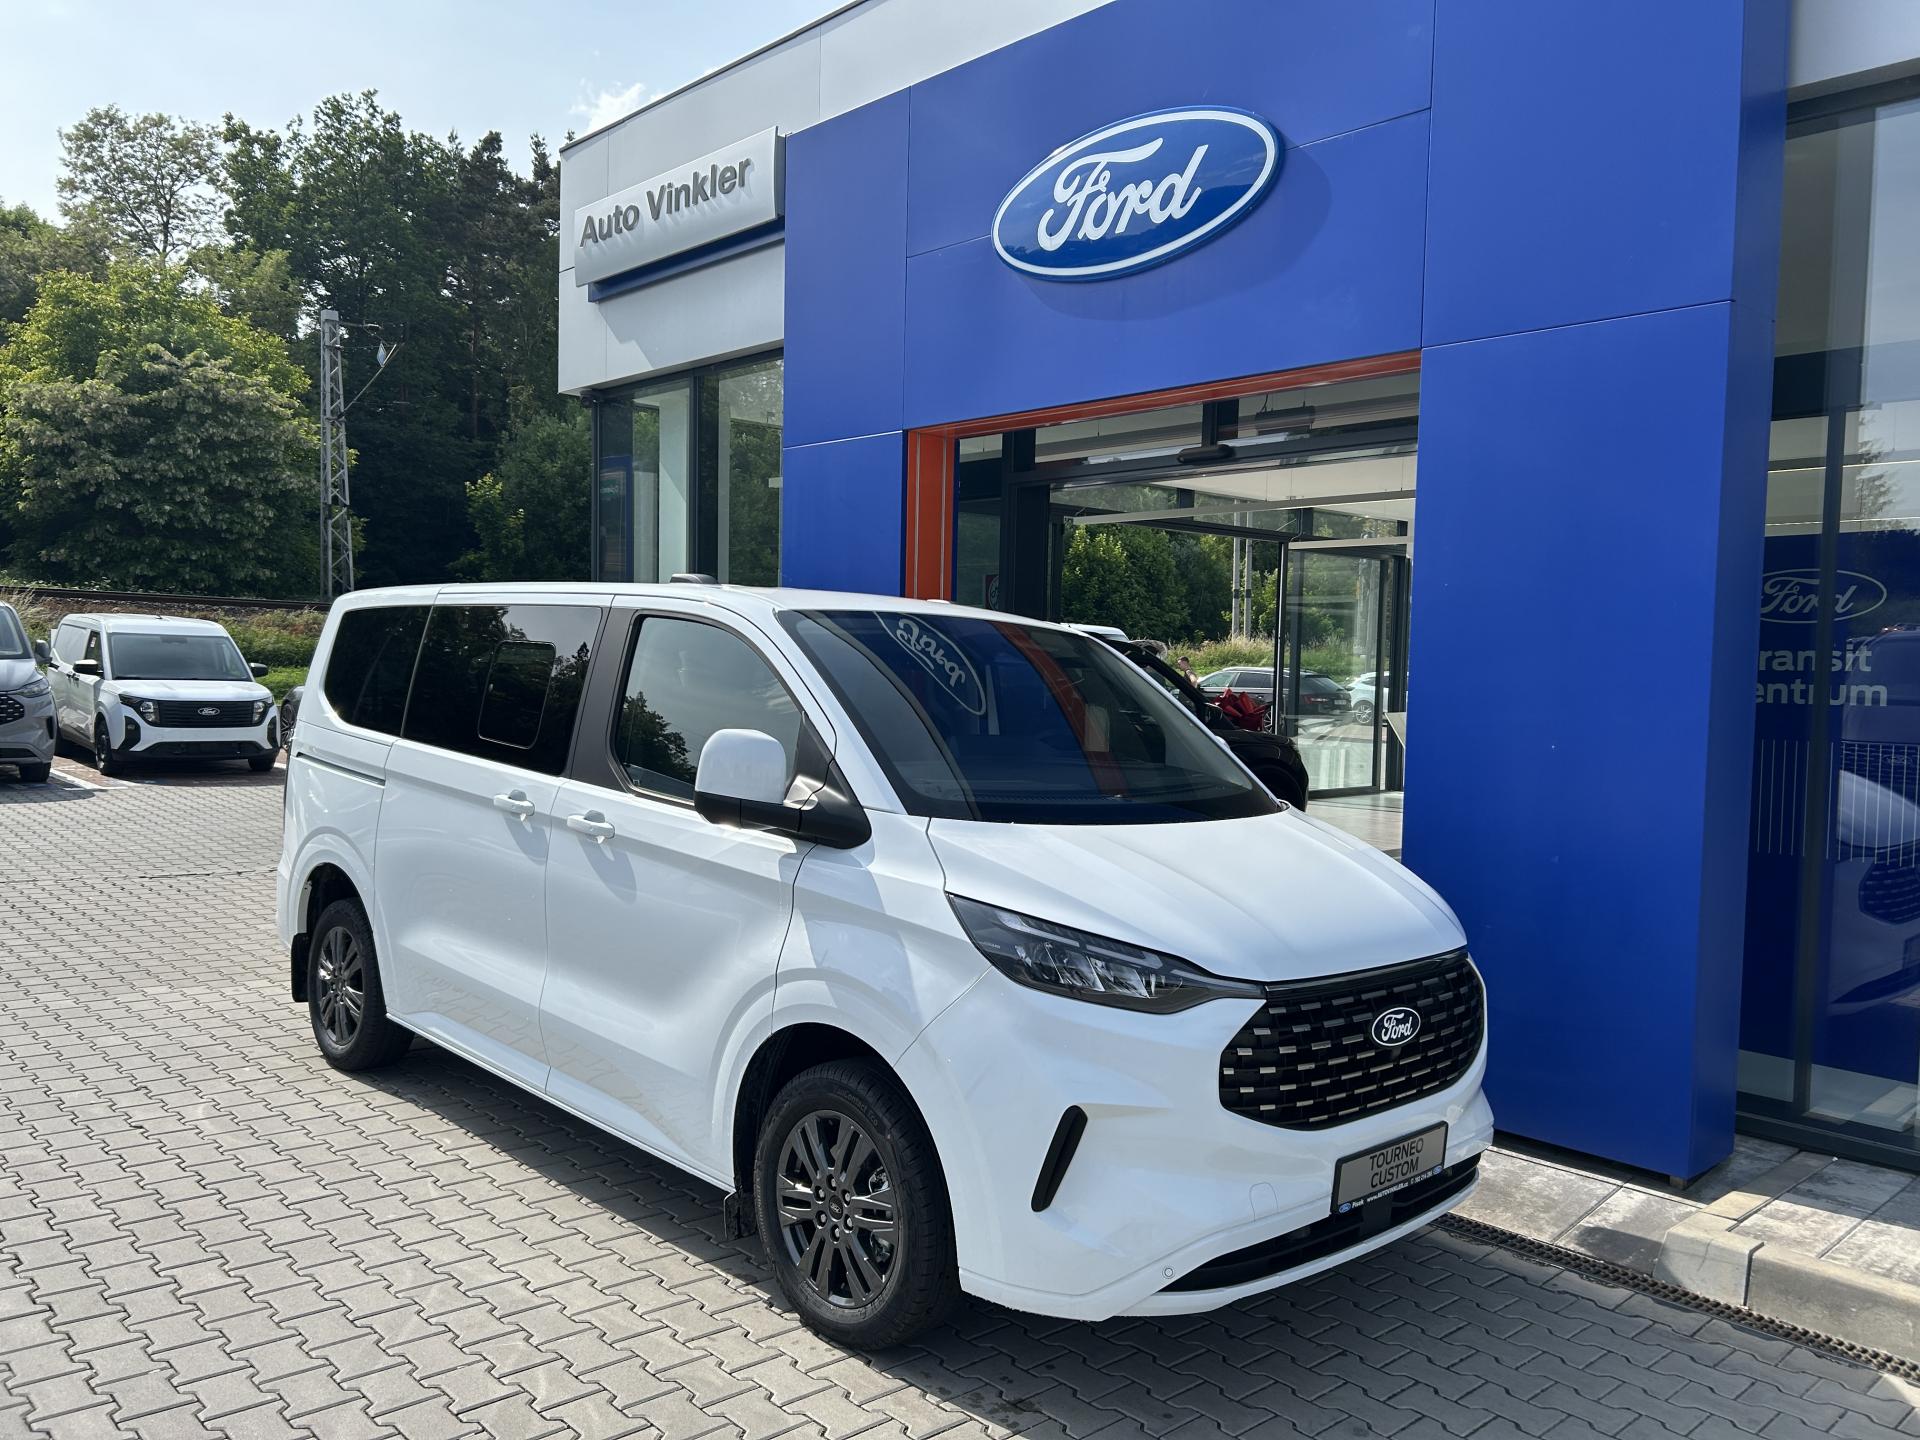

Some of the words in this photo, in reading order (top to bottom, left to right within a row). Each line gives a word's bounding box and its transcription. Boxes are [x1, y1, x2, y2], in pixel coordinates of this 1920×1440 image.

[580, 204, 640, 248] Auto
[646, 158, 751, 221] Vinkler
[1037, 137, 1209, 251] Ford
[1759, 644, 1873, 672] ransit
[1381, 1012, 1413, 1042] Ford
[1369, 1137, 1424, 1171] TOURNEO
[1370, 1156, 1420, 1189] CUSTOM
